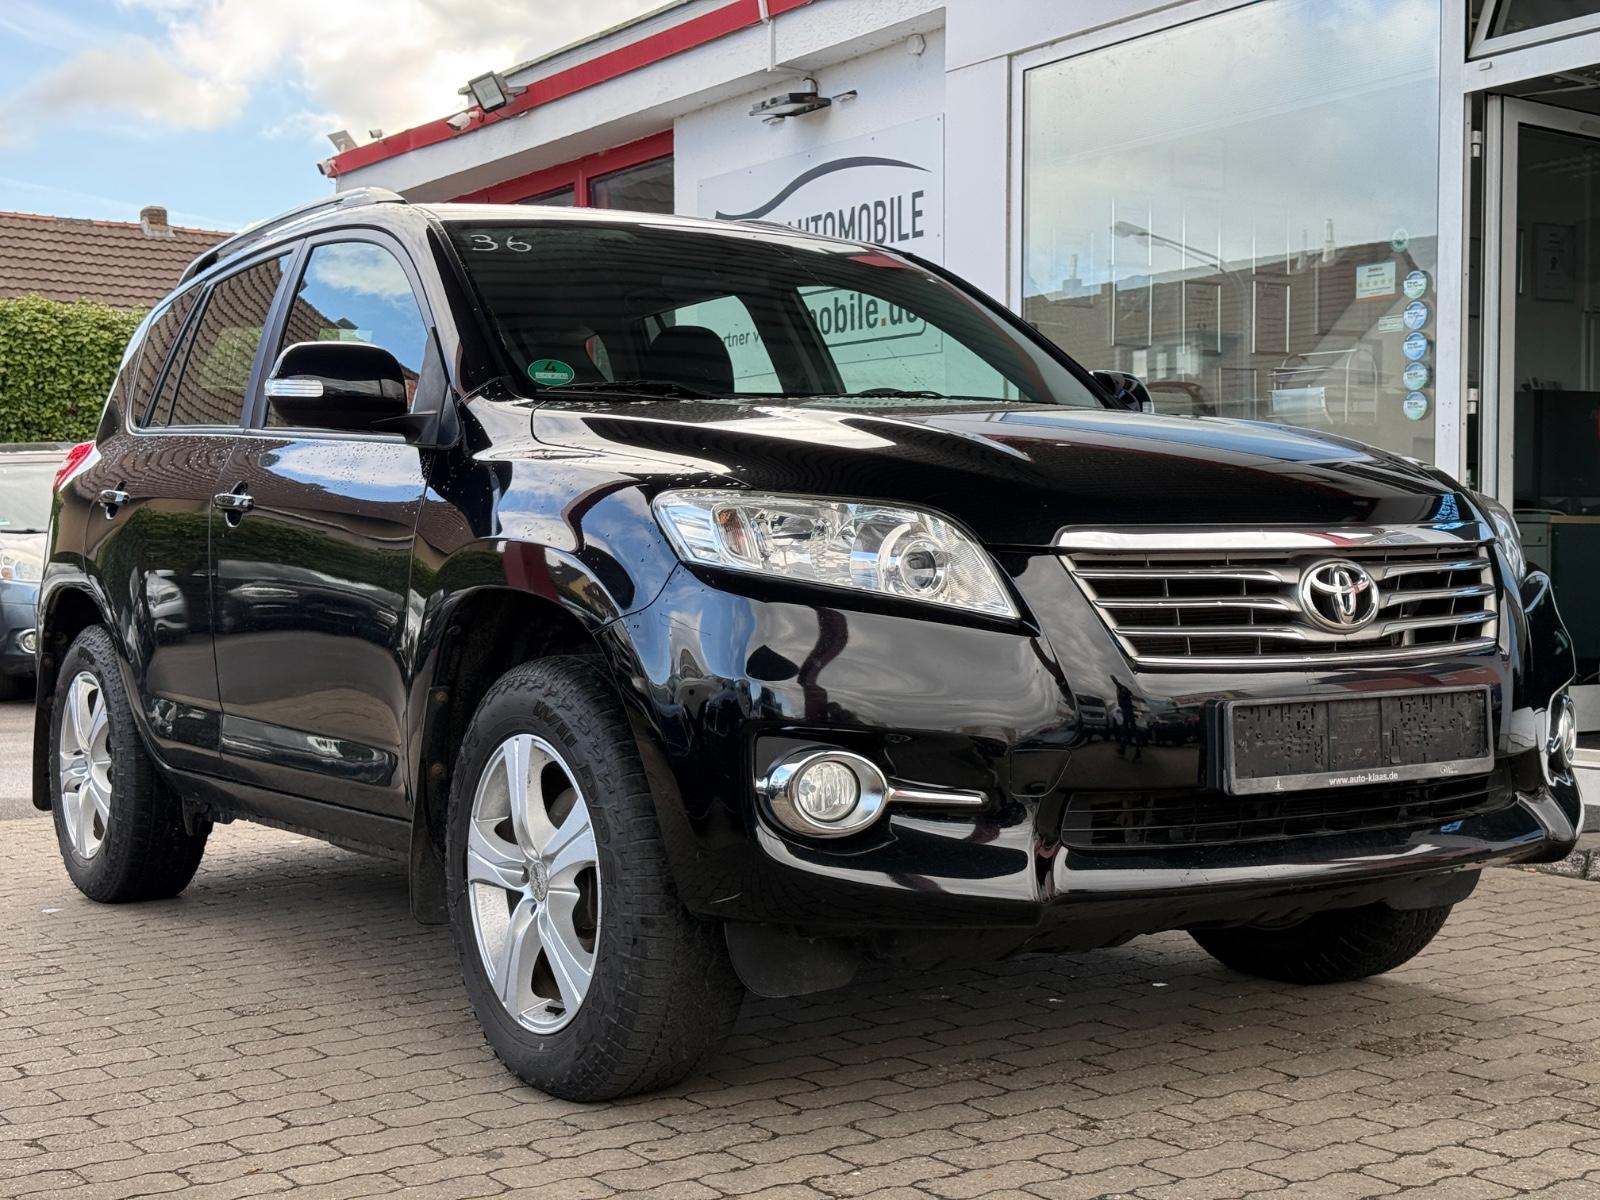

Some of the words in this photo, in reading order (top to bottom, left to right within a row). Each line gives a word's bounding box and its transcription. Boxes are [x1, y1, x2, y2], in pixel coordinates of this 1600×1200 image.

[787, 190, 924, 245] TOMOBILE
[470, 234, 532, 252] 36
[723, 332, 750, 348] rtner
[544, 361, 557, 373] 4
[1328, 771, 1399, 786] www.auto-klaas.de
